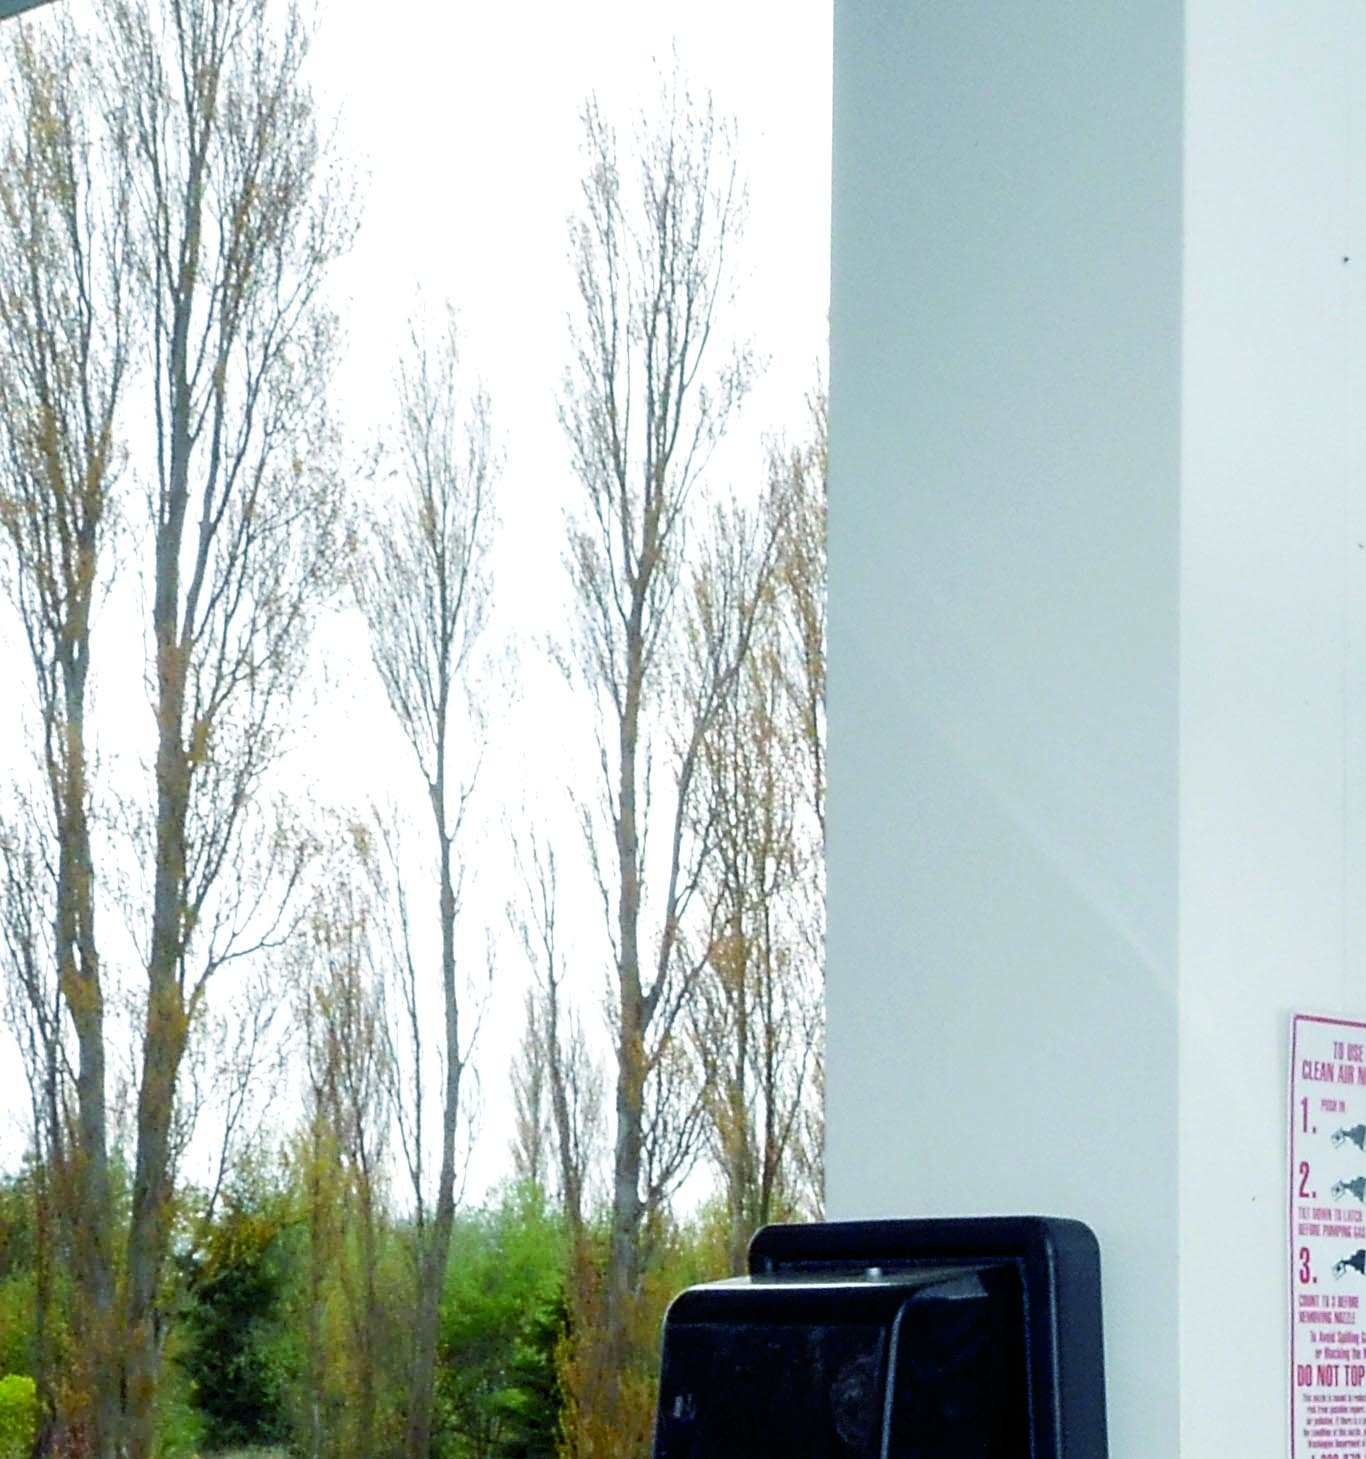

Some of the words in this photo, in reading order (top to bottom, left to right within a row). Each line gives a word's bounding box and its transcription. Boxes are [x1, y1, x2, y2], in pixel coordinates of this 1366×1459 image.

[1334, 1041, 1344, 1059] TO
[1347, 1044, 1363, 1062] USE
[1302, 1059, 1334, 1082] CLEAN
[1338, 1064, 1354, 1084] AIR
[1301, 1097, 1316, 1134] 1.
[1299, 1161, 1317, 1198] 2.
[1299, 1247, 1317, 1284] 3.
[1298, 1364, 1312, 1386] DO
[1318, 1365, 1339, 1386] NOT
[1344, 1365, 1365, 1386] TOP
